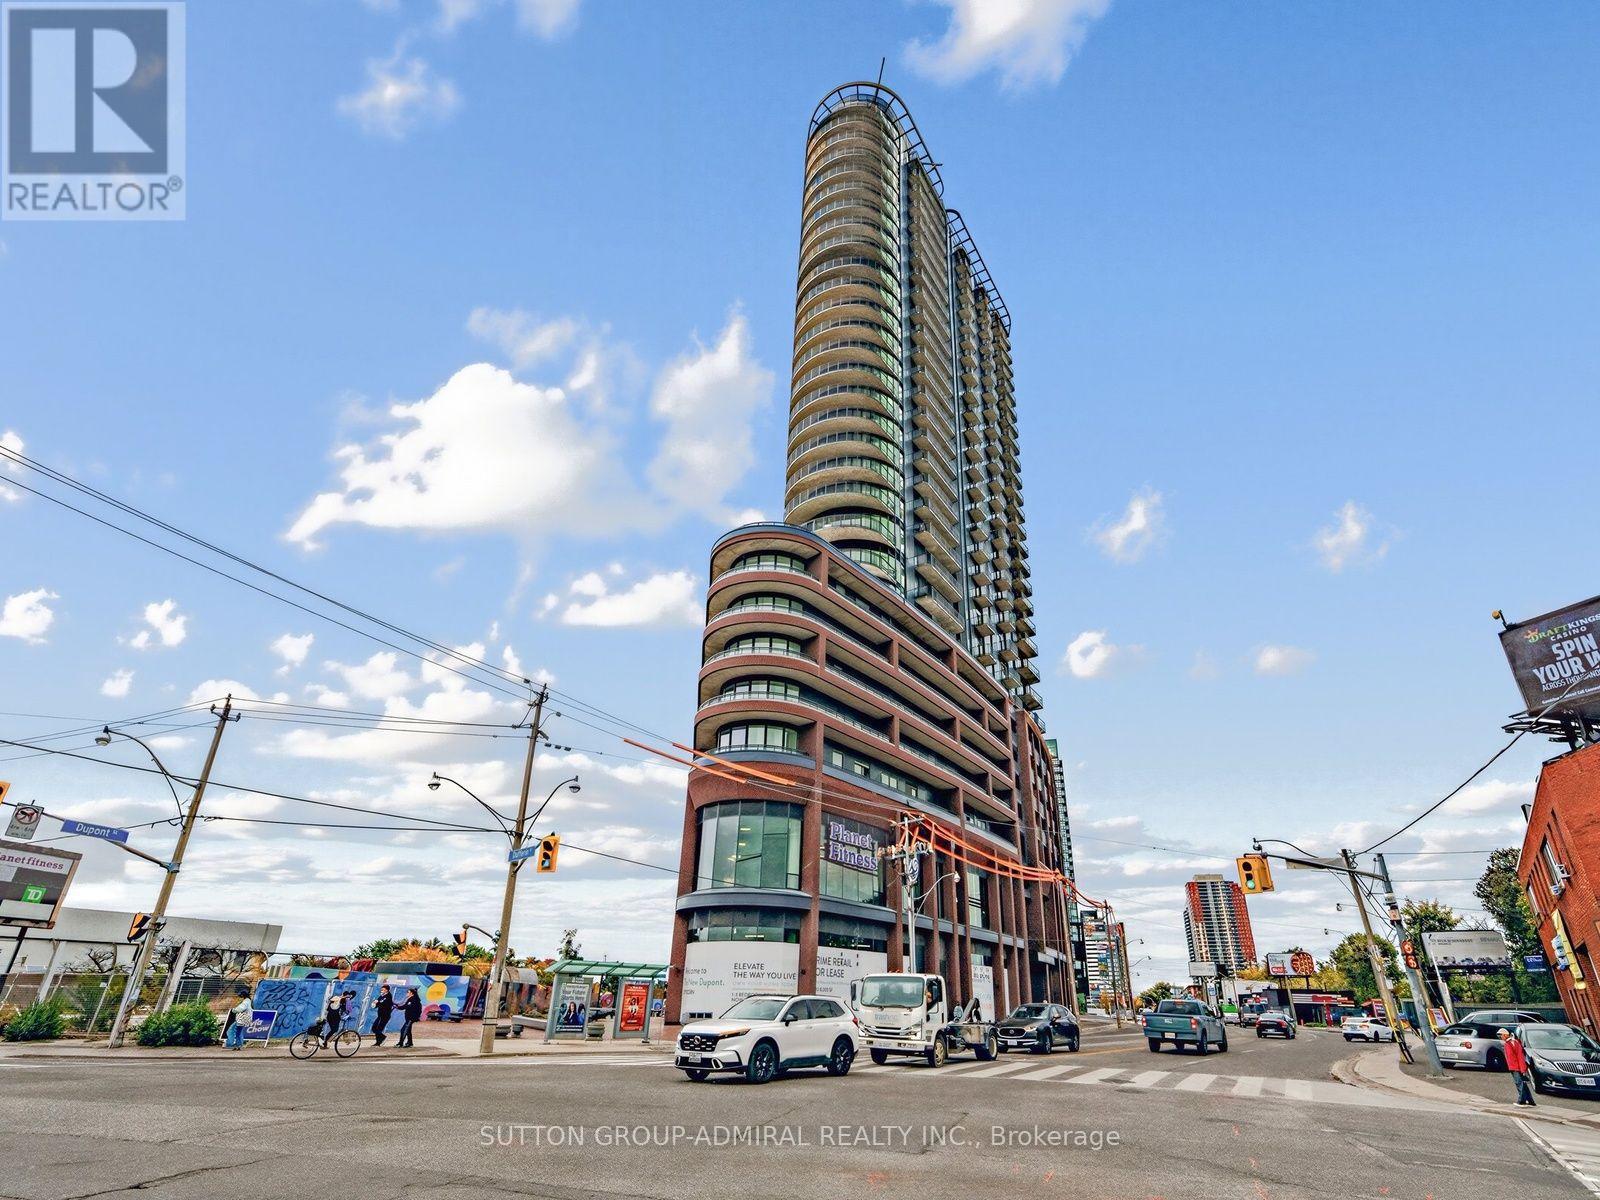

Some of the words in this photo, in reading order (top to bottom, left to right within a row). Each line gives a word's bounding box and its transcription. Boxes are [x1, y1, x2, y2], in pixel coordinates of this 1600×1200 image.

[1550, 625, 1587, 641] CASINO
[1551, 632, 1599, 661] SPIN
[1532, 656, 1586, 685] YOUR
[1542, 678, 1567, 692] ACROSS
[75, 823, 110, 837] Dupont
[829, 821, 873, 850] Planet
[828, 840, 878, 870] Fitness
[26, 856, 64, 870] fitness
[28, 888, 42, 900] TD
[733, 962, 765, 971] ELEVATE
[832, 957, 852, 967] RETAIL
[733, 971, 748, 979] THE
[826, 968, 845, 978] LEASE
[247, 1025, 269, 1034] Chow
